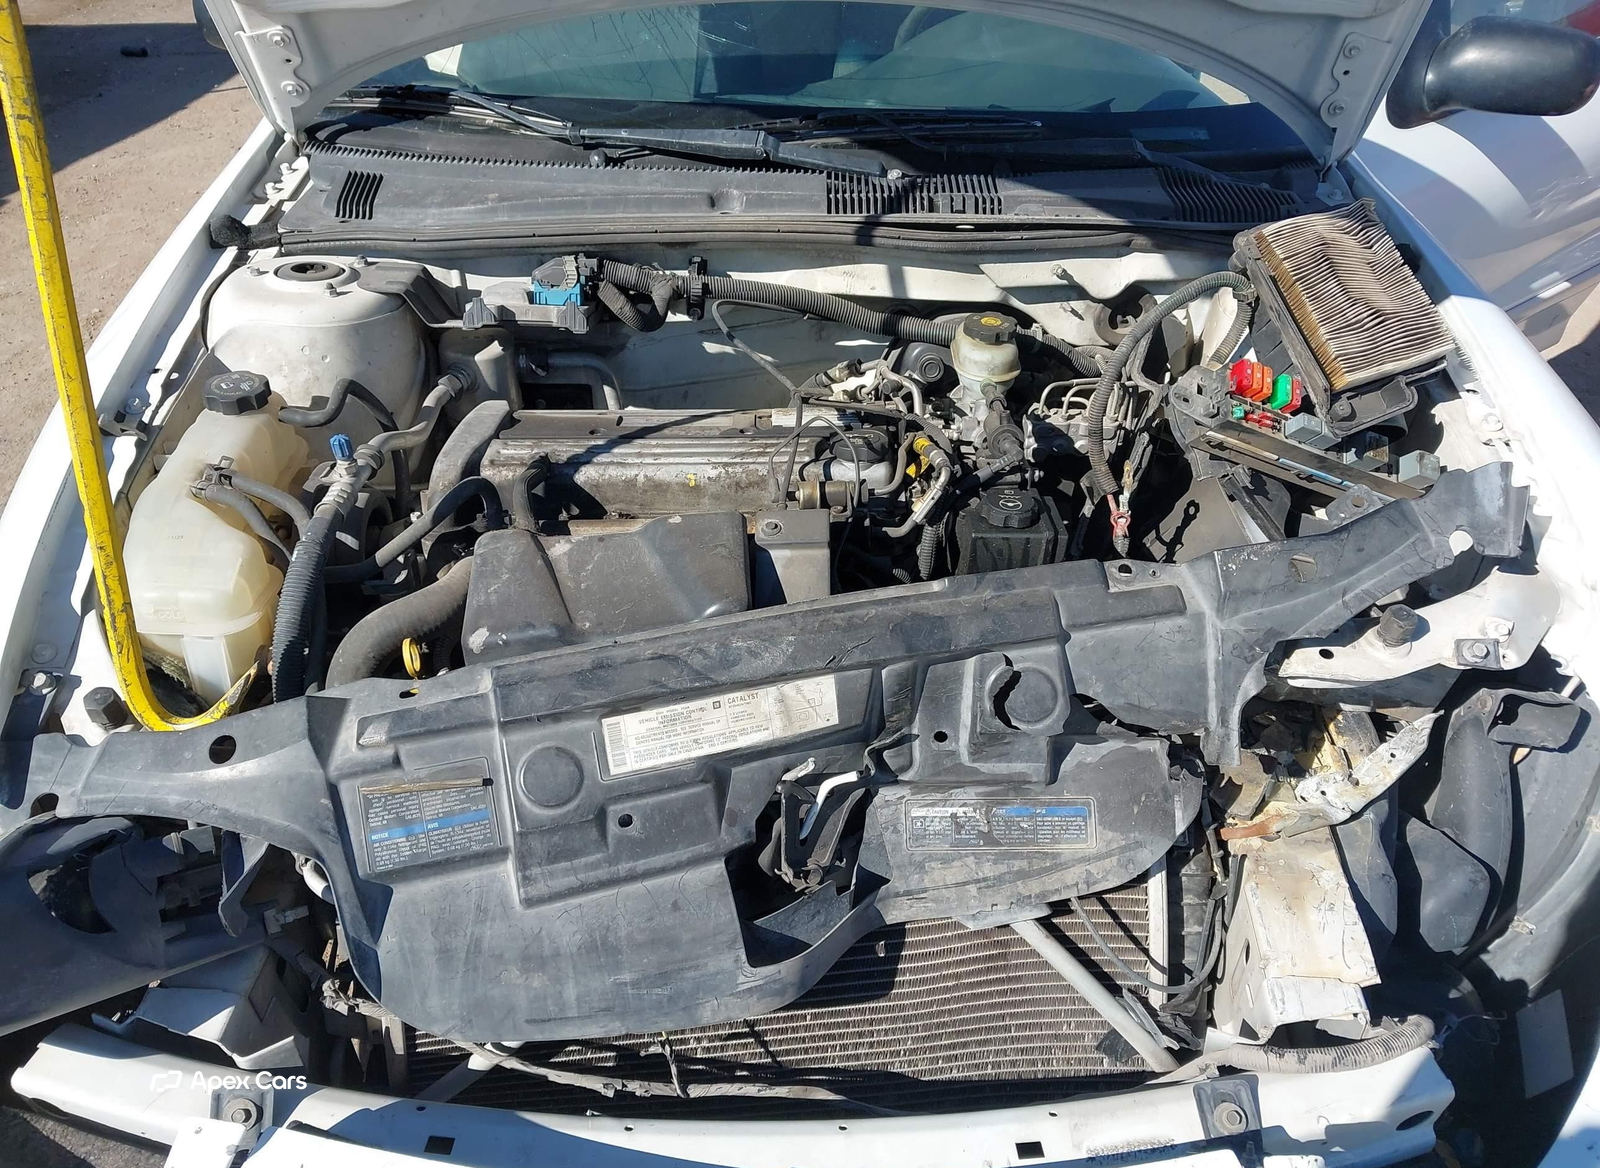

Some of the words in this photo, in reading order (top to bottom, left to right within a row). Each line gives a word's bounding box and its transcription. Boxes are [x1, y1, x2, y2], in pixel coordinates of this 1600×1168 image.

[727, 693, 759, 704] CATALYST
[639, 716, 659, 724] VEHICLE
[661, 711, 684, 720] EMISSION
[658, 715, 692, 725] INFORMATION
